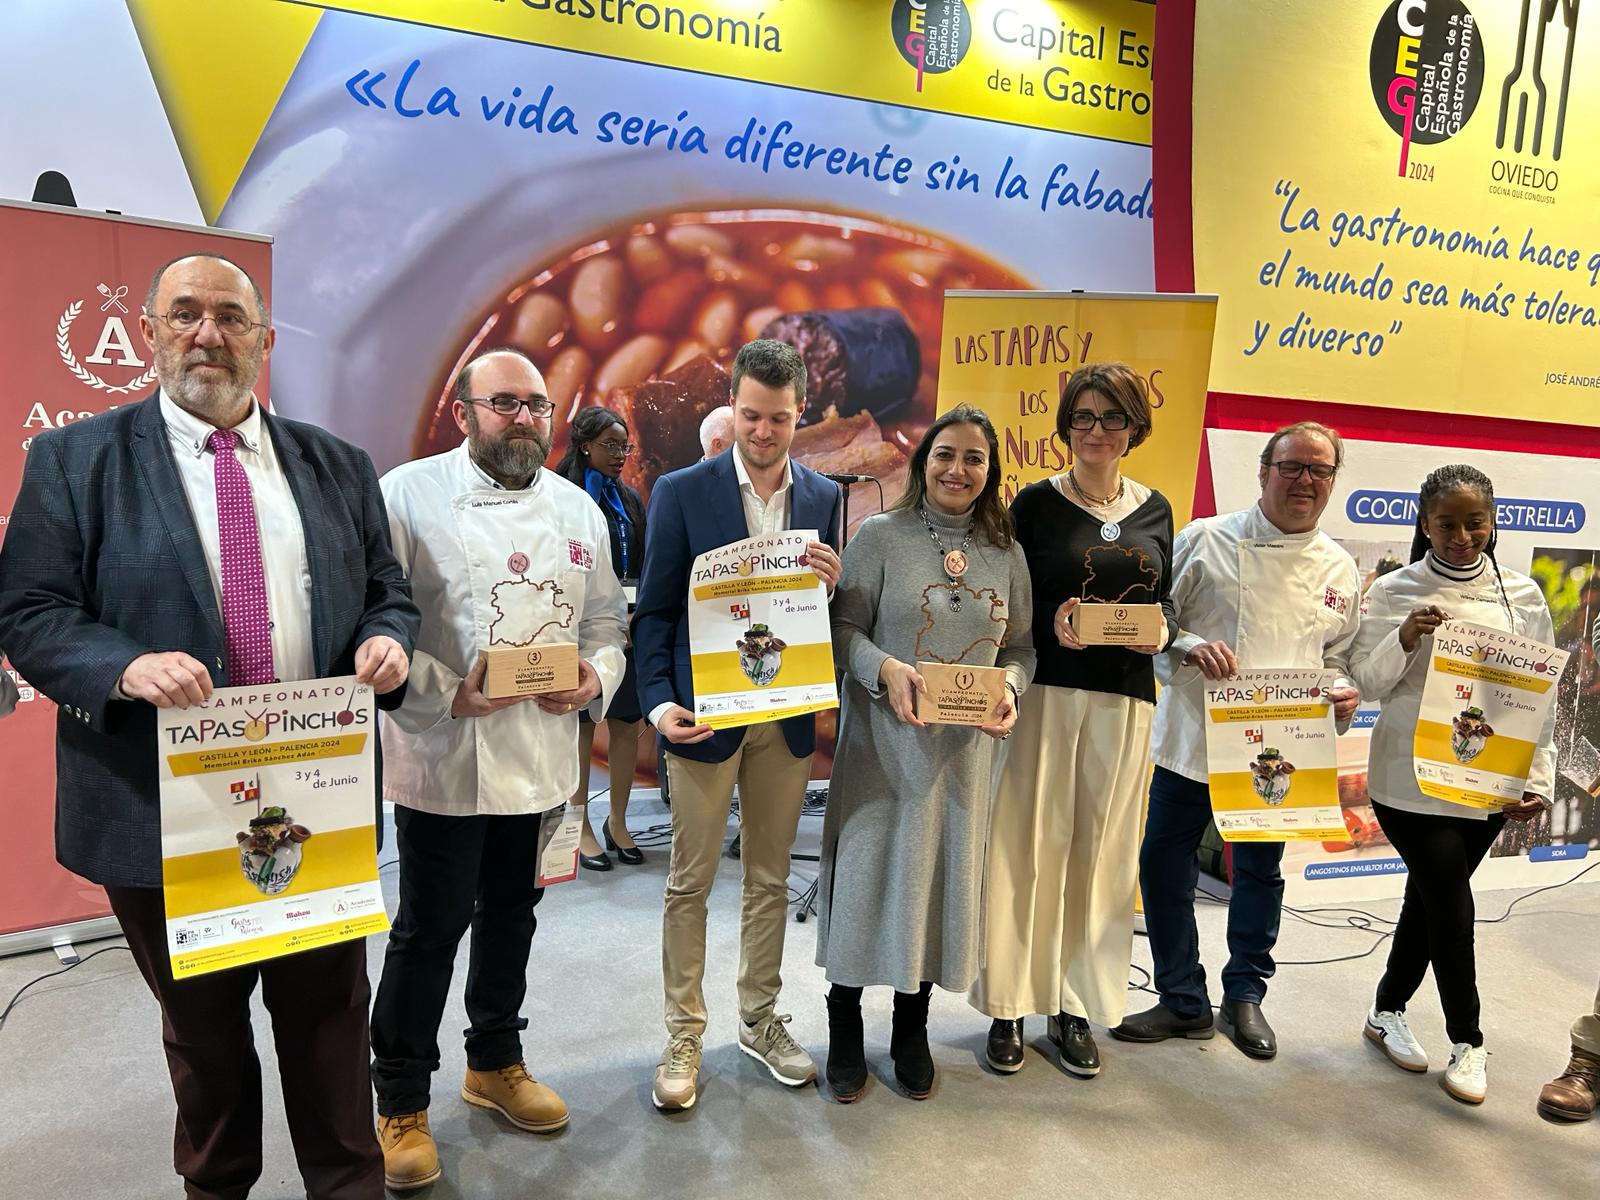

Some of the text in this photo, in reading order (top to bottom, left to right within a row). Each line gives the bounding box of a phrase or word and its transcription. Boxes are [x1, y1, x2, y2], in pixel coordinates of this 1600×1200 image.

[520, 0, 783, 52] astronomía
[947, 0, 961, 69] Gastronomí
[925, 26, 938, 66] Capital
[936, 18, 950, 68] Española
[993, 8, 1153, 80] Capital Es
[1430, 14, 1458, 135] Española de la
[1446, 13, 1475, 138] Gastronomía
[987, 66, 1150, 116] de la Gastro
[1415, 63, 1436, 132] Capital
[481, 84, 579, 135] vida
[596, 110, 709, 154] sería
[725, 117, 912, 173] diferente
[925, 155, 979, 193] sin
[995, 156, 1029, 200] la
[1041, 163, 1153, 220] fabad
[1409, 162, 1435, 182] 2024
[1491, 160, 1559, 191] OVIEDO
[1489, 185, 1556, 205] COCINA QUE CONQUISTA
[1329, 207, 1509, 260] gastronomía
[1519, 228, 1580, 271] hace
[1259, 248, 1600, 327] el mundo sea más tolera
[85, 316, 146, 368] A
[954, 324, 1093, 367] LAS TAPAS Y
[1244, 319, 1270, 357] y
[1545, 372, 1568, 386] JOSÉ
[1020, 389, 1049, 417] LOS
[1355, 496, 1419, 520] COCIN
[1495, 504, 1577, 529] ESTRELLA
[705, 536, 803, 562] V CAMPEONATO
[694, 562, 739, 582] TAPAS
[711, 583, 736, 591] CASTILLA
[773, 598, 778, 606] 3
[779, 599, 784, 607] y
[785, 604, 817, 613] de Junio
[1118, 609, 1124, 617] 2
[1436, 639, 1474, 657] TAPAS
[1453, 626, 1547, 654] CAMPEONATO
[532, 652, 538, 661] 3
[962, 674, 967, 684] 1
[1490, 670, 1517, 681] PALENCIA
[200, 686, 369, 709] CAMPEONATO de
[1208, 687, 1253, 703] TAPAS
[1500, 691, 1506, 699] y
[1503, 700, 1536, 712] de Junio
[165, 718, 246, 745] TAPAS
[199, 739, 340, 762] CASTILLA Y LEÓN PALENCIA 2024
[204, 751, 315, 769] Memorial Erika Sánchez Adán
[295, 769, 321, 782] 3 y 4
[313, 775, 358, 789] de Junio
[1306, 866, 1349, 876] LANGOSTINOS
[1350, 864, 1382, 873] ENVUELTOS
[1383, 862, 1395, 870] POR
[286, 909, 311, 919] Mahou
